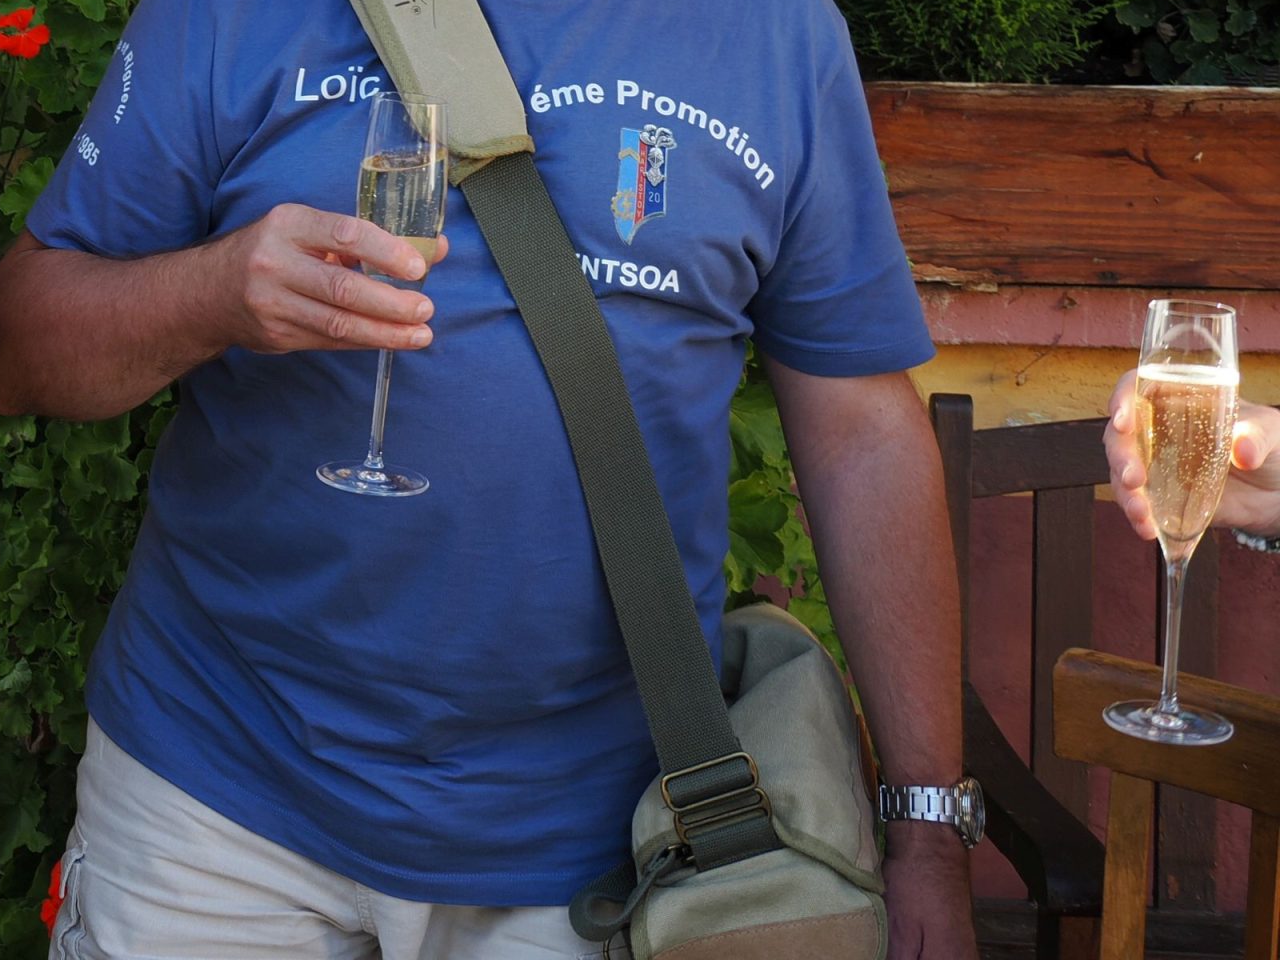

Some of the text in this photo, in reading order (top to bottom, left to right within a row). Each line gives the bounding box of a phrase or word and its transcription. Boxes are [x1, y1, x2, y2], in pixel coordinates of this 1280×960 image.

[294, 65, 380, 102] Loïc
[529, 79, 775, 190] éme Promotion
[648, 191, 661, 203] 20
[576, 253, 680, 293] NTSOA
